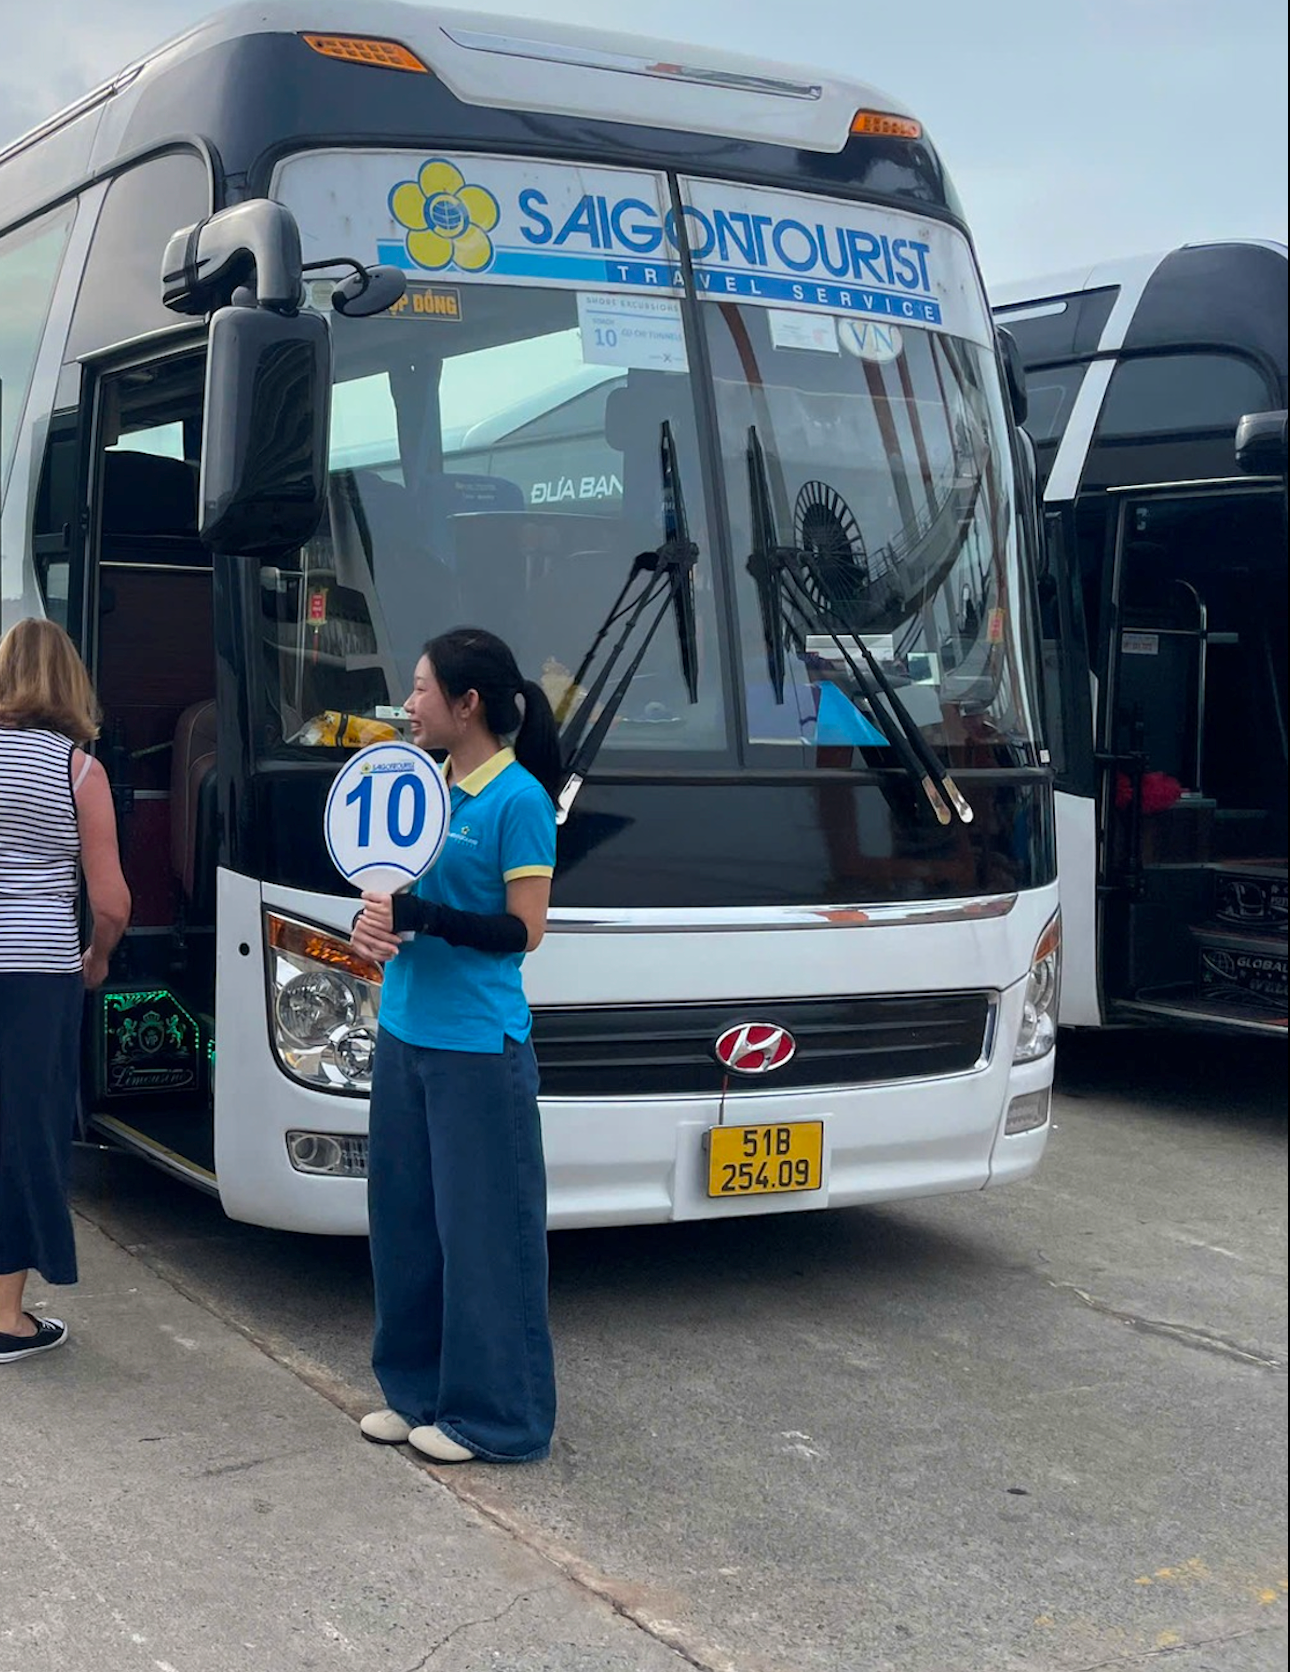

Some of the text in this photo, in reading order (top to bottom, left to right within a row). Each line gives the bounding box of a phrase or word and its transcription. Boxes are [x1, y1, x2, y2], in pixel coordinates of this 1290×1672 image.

[518, 188, 931, 292] SAIGONTOURIST
[617, 264, 937, 322] TRAVEL SERVICE
[594, 328, 618, 348] 10
[847, 321, 895, 353] VN
[530, 475, 576, 504] ĐƯA
[345, 773, 427, 848] 10
[742, 1127, 791, 1158] 51B
[720, 1158, 810, 1192] 254.09
